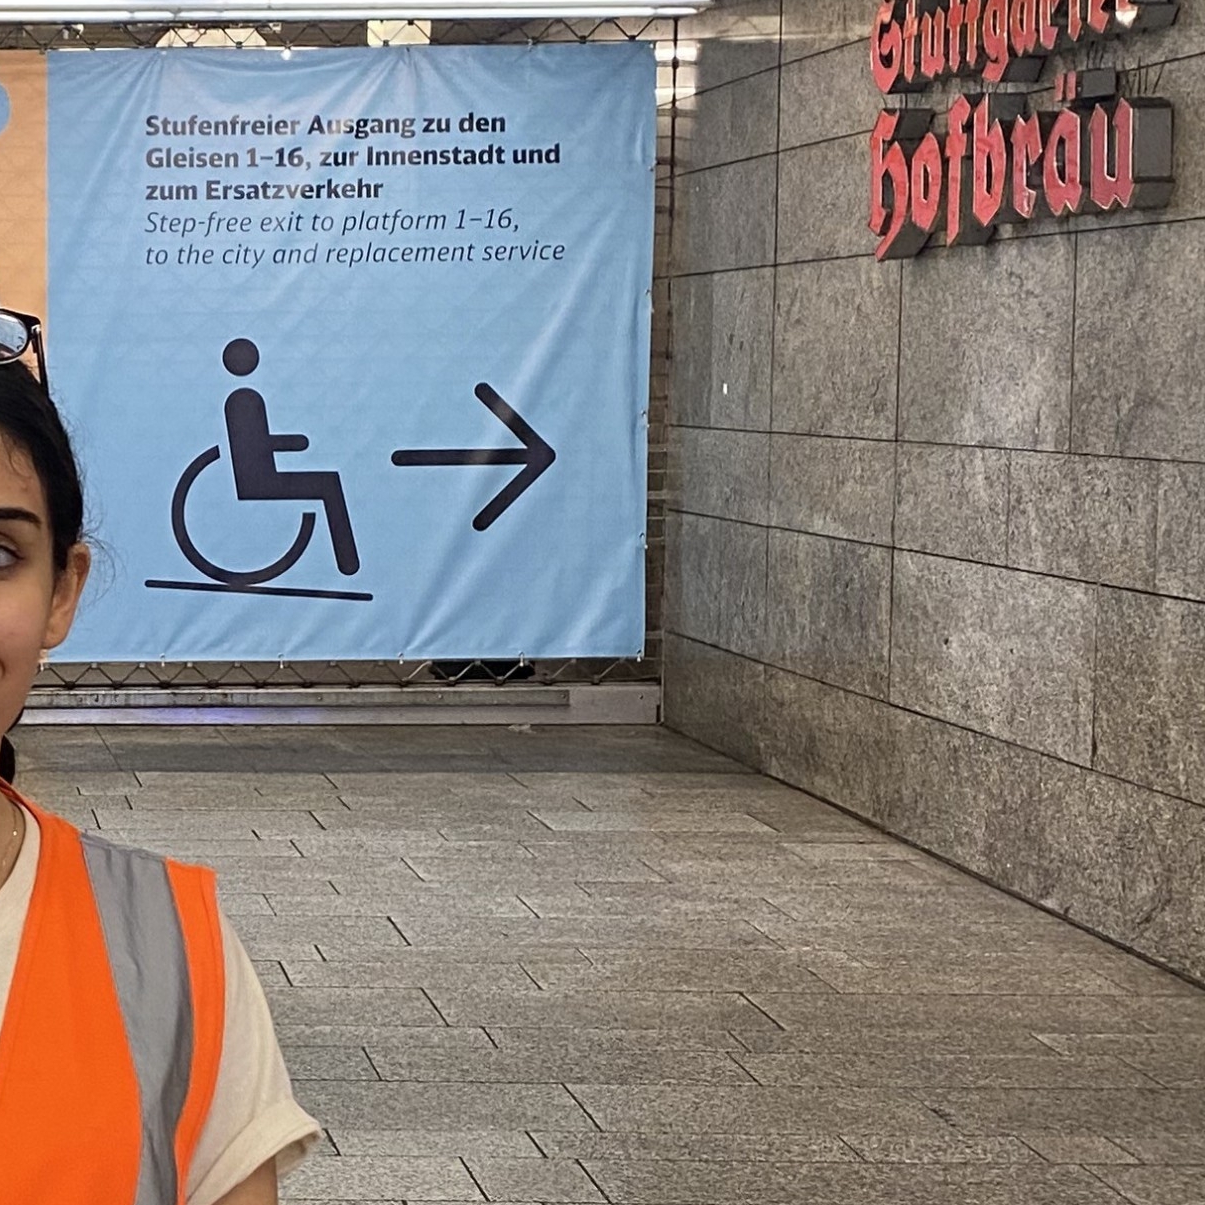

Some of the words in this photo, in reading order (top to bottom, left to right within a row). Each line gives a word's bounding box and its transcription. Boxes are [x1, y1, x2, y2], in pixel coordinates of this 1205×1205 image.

[146, 115, 300, 136] Stufenfreier
[308, 115, 416, 139] Ausgang
[422, 118, 450, 133] zu
[459, 112, 505, 132] den
[146, 147, 238, 168] Gleisen
[247, 147, 310, 170] 1–16,
[320, 151, 358, 167] zur
[367, 144, 505, 166] Innenstadt
[513, 143, 560, 164] und
[146, 185, 197, 200] zum
[206, 178, 383, 200] Ersatzverkehr
[145, 211, 251, 238] Step-free
[260, 211, 304, 232] exit
[312, 214, 333, 231] to
[342, 209, 446, 236] platform
[456, 208, 518, 232] 1–16,
[146, 248, 168, 264] to
[178, 244, 214, 264] the
[223, 244, 265, 268] city
[273, 243, 318, 264] and
[326, 242, 475, 267] replacement
[482, 240, 565, 261] service
